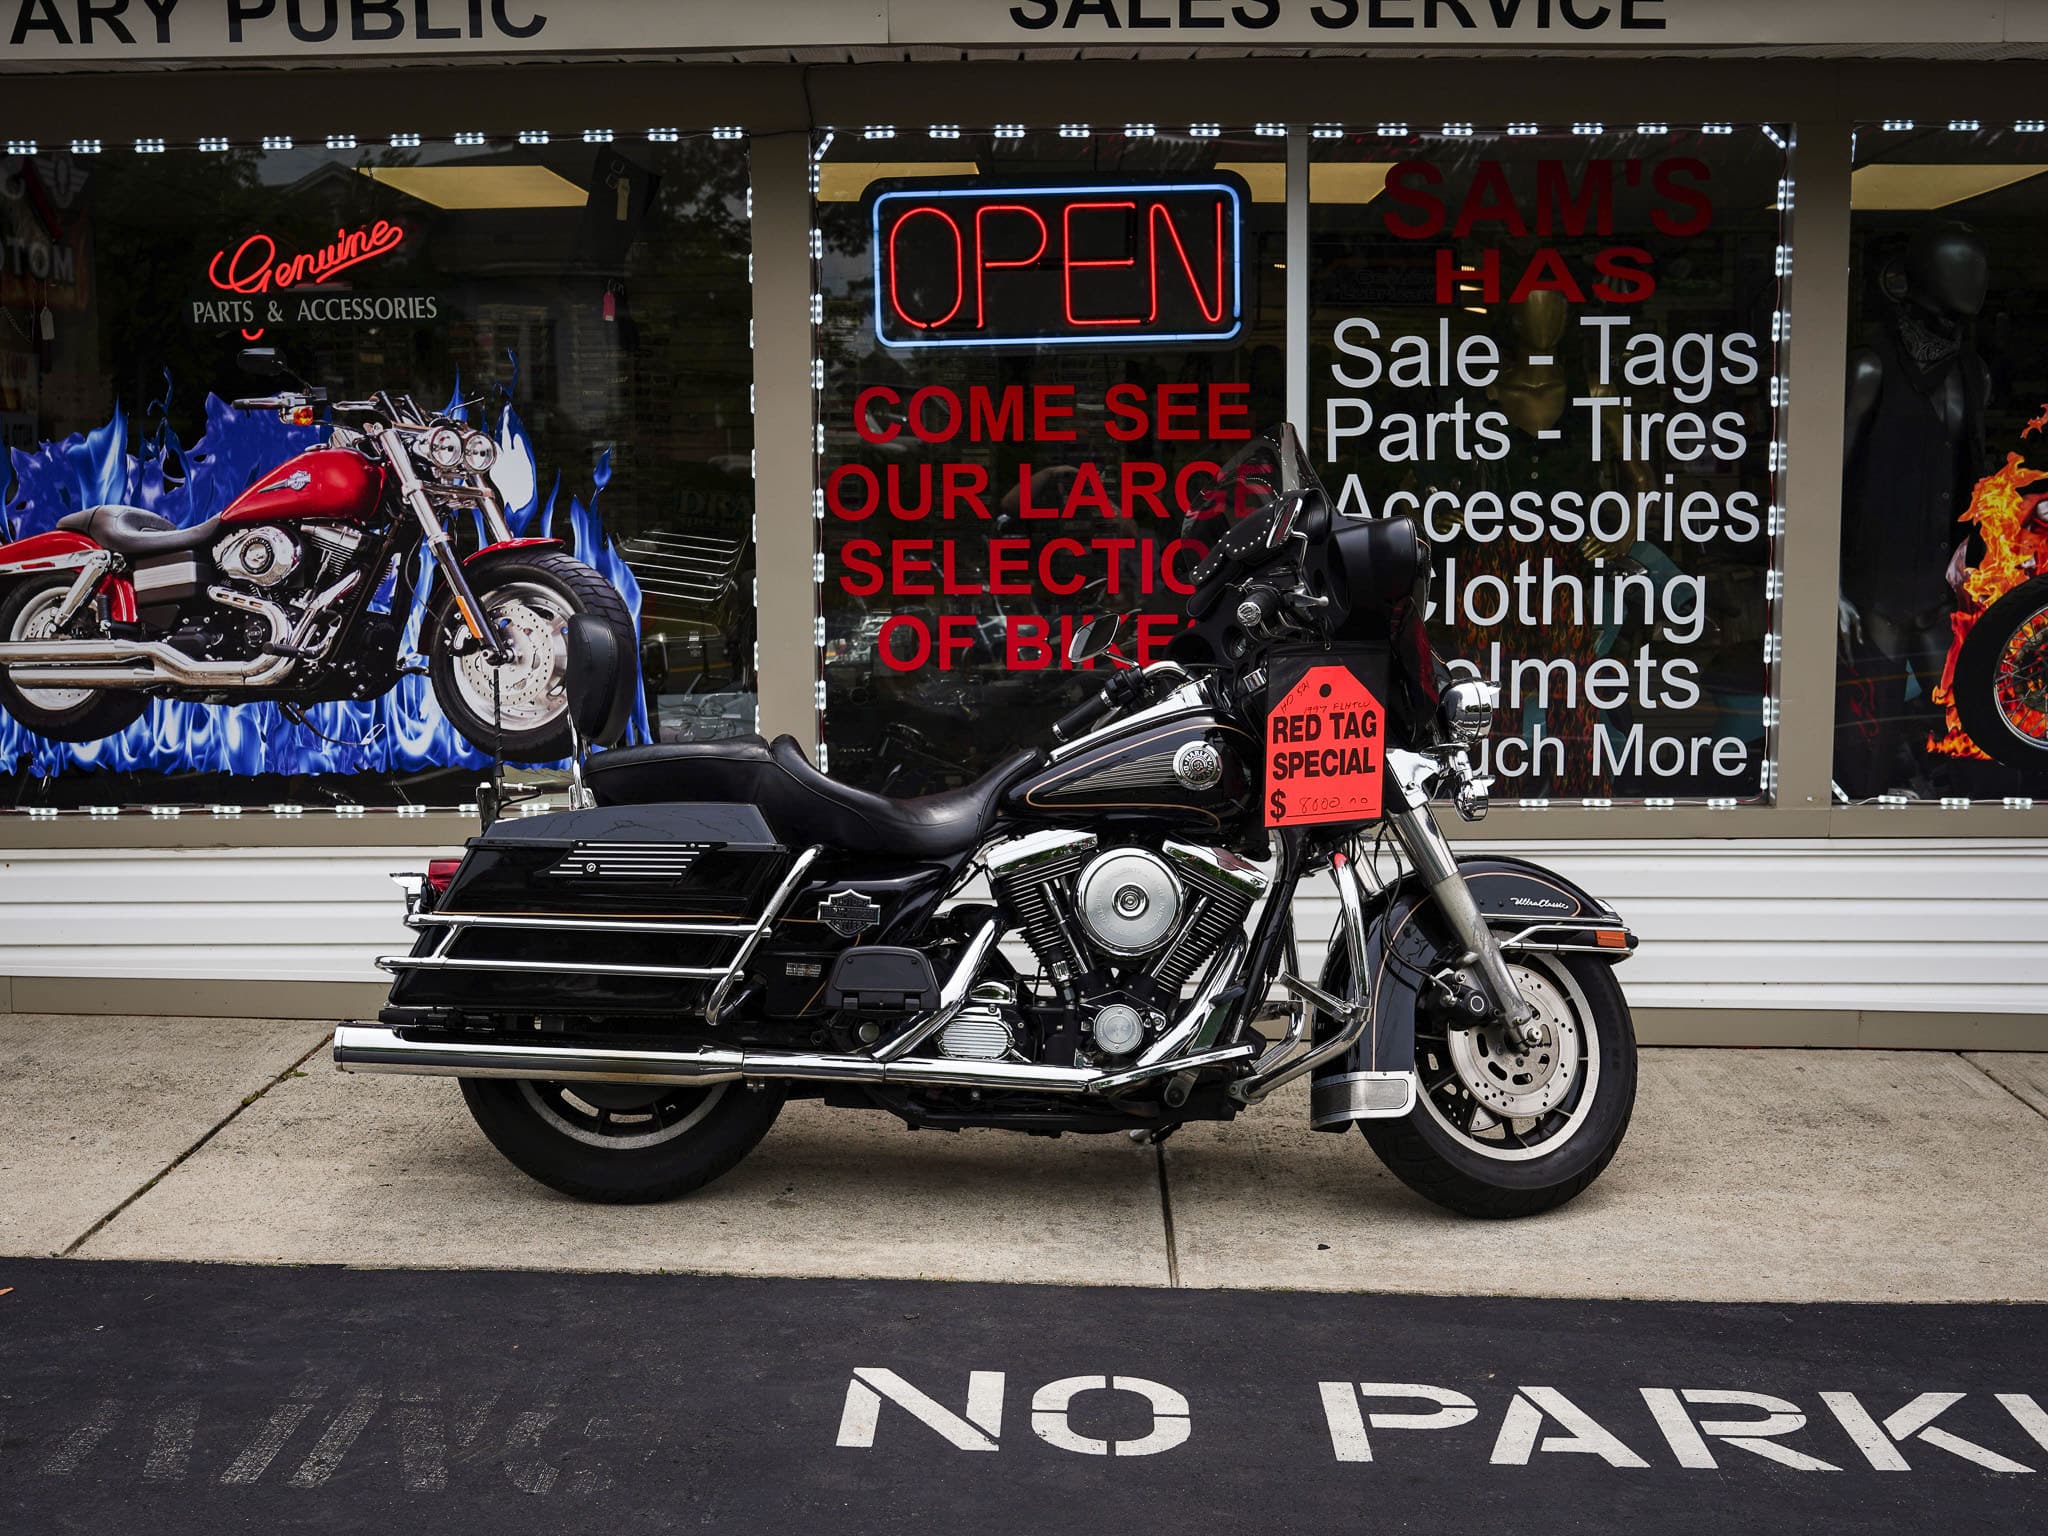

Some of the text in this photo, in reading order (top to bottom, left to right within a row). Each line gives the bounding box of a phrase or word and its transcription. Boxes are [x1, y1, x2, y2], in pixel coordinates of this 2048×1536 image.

[9, 0, 547, 44] ARY PUBLIC
[1384, 157, 1713, 239] SAM'S
[208, 219, 404, 294] Genuine
[890, 202, 1223, 329] OPEN
[1435, 247, 1656, 304] HAS
[193, 296, 437, 323] PARTS & ACCESSORIES
[1331, 317, 1500, 388] Sale
[1580, 316, 1759, 403] Tags
[853, 383, 1253, 443] COME SEE
[1326, 396, 1511, 462] Parts
[826, 461, 1274, 522] OUR LARGE
[840, 538, 1210, 595] SELECTIO
[1424, 557, 1705, 644] lothing
[877, 614, 1196, 672] OF BIKE
[1273, 710, 1377, 744] RED TAG
[1592, 724, 1748, 776] More
[1272, 747, 1376, 781] SPECIAL
[1270, 788, 1287, 822] $
[836, 1367, 1192, 1456] NO
